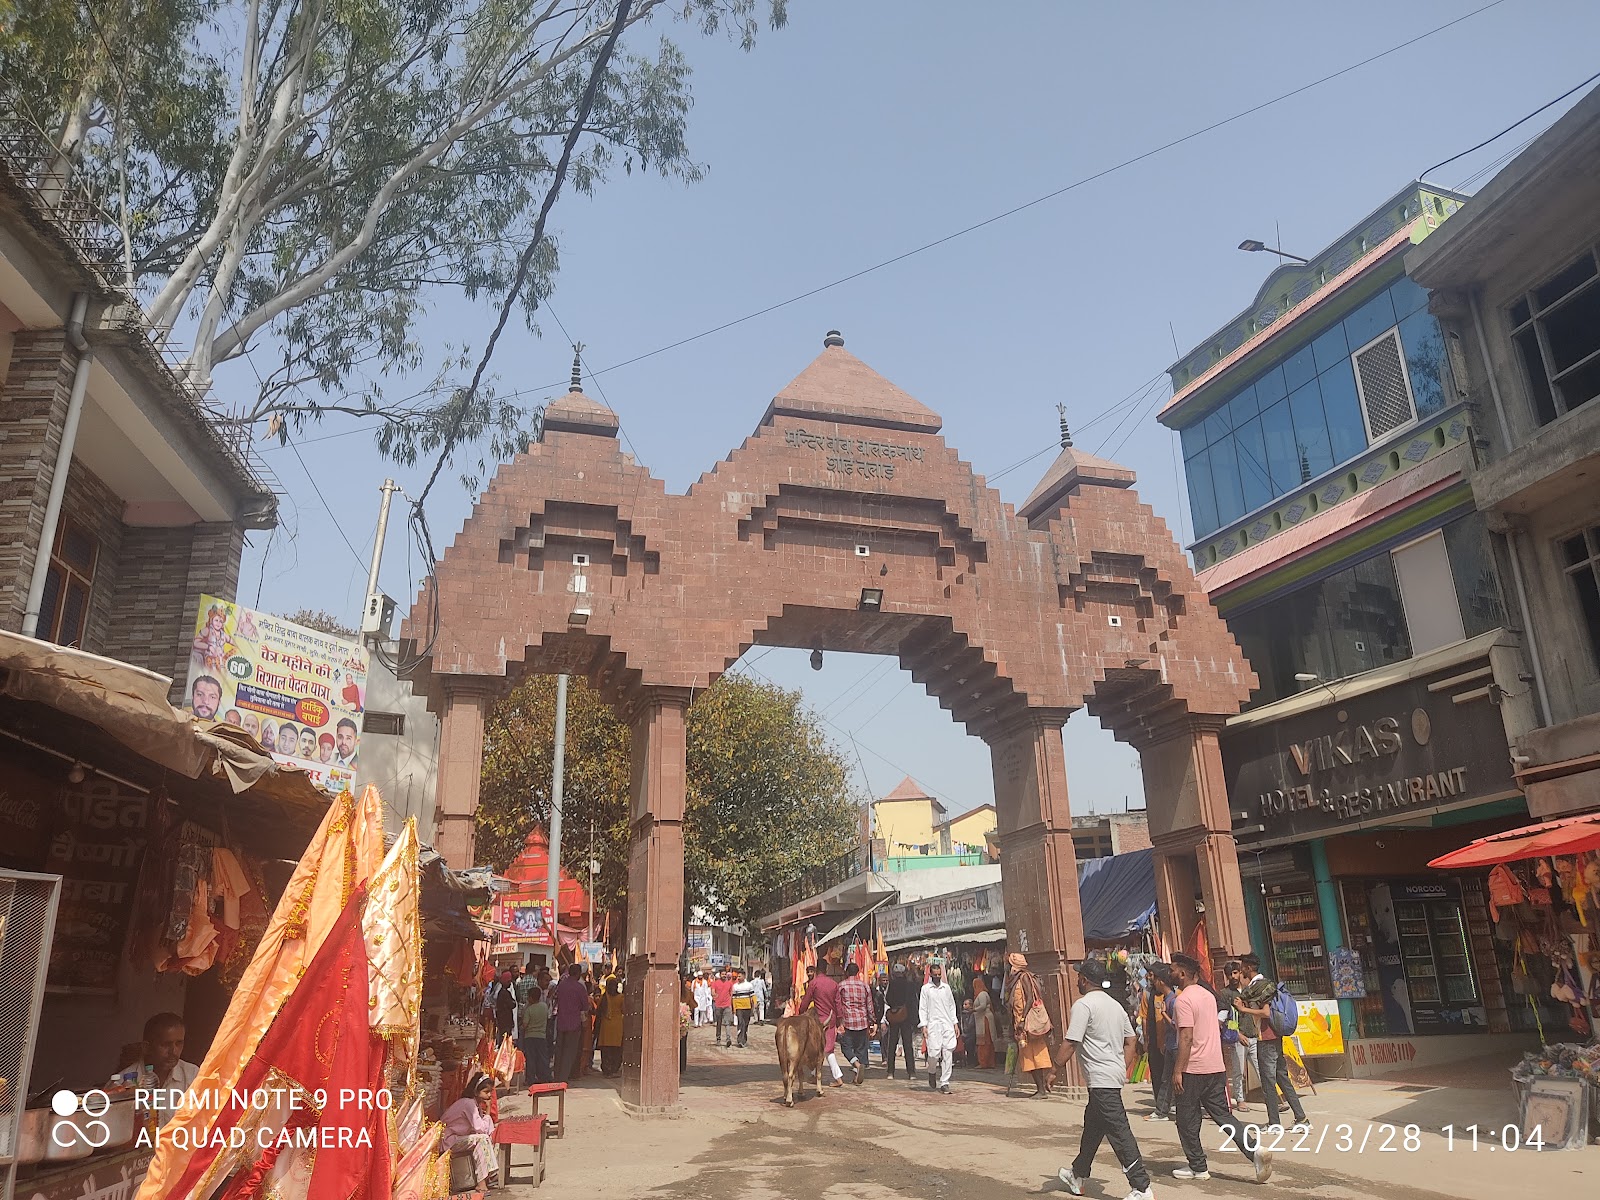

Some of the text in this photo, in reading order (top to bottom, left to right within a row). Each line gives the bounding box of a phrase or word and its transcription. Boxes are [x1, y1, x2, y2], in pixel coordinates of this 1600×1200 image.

[827, 437, 854, 455] बाबा
[827, 456, 855, 475] शाह
[261, 645, 280, 664] चैत्र
[281, 651, 313, 674] महीने
[315, 663, 331, 679] की
[255, 664, 331, 701] विशाल पैदल यात्रा
[301, 700, 325, 715] हार्दिक
[301, 713, 322, 725] बधाई
[1289, 716, 1402, 776] VIKAS
[1259, 766, 1467, 820] HOTEL & RESTAURANT
[1405, 885, 1446, 894] NORCOOL
[915, 897, 977, 919] शर्मा मूर्ति भण्डार
[1352, 1042, 1398, 1066] CAR PARKING
